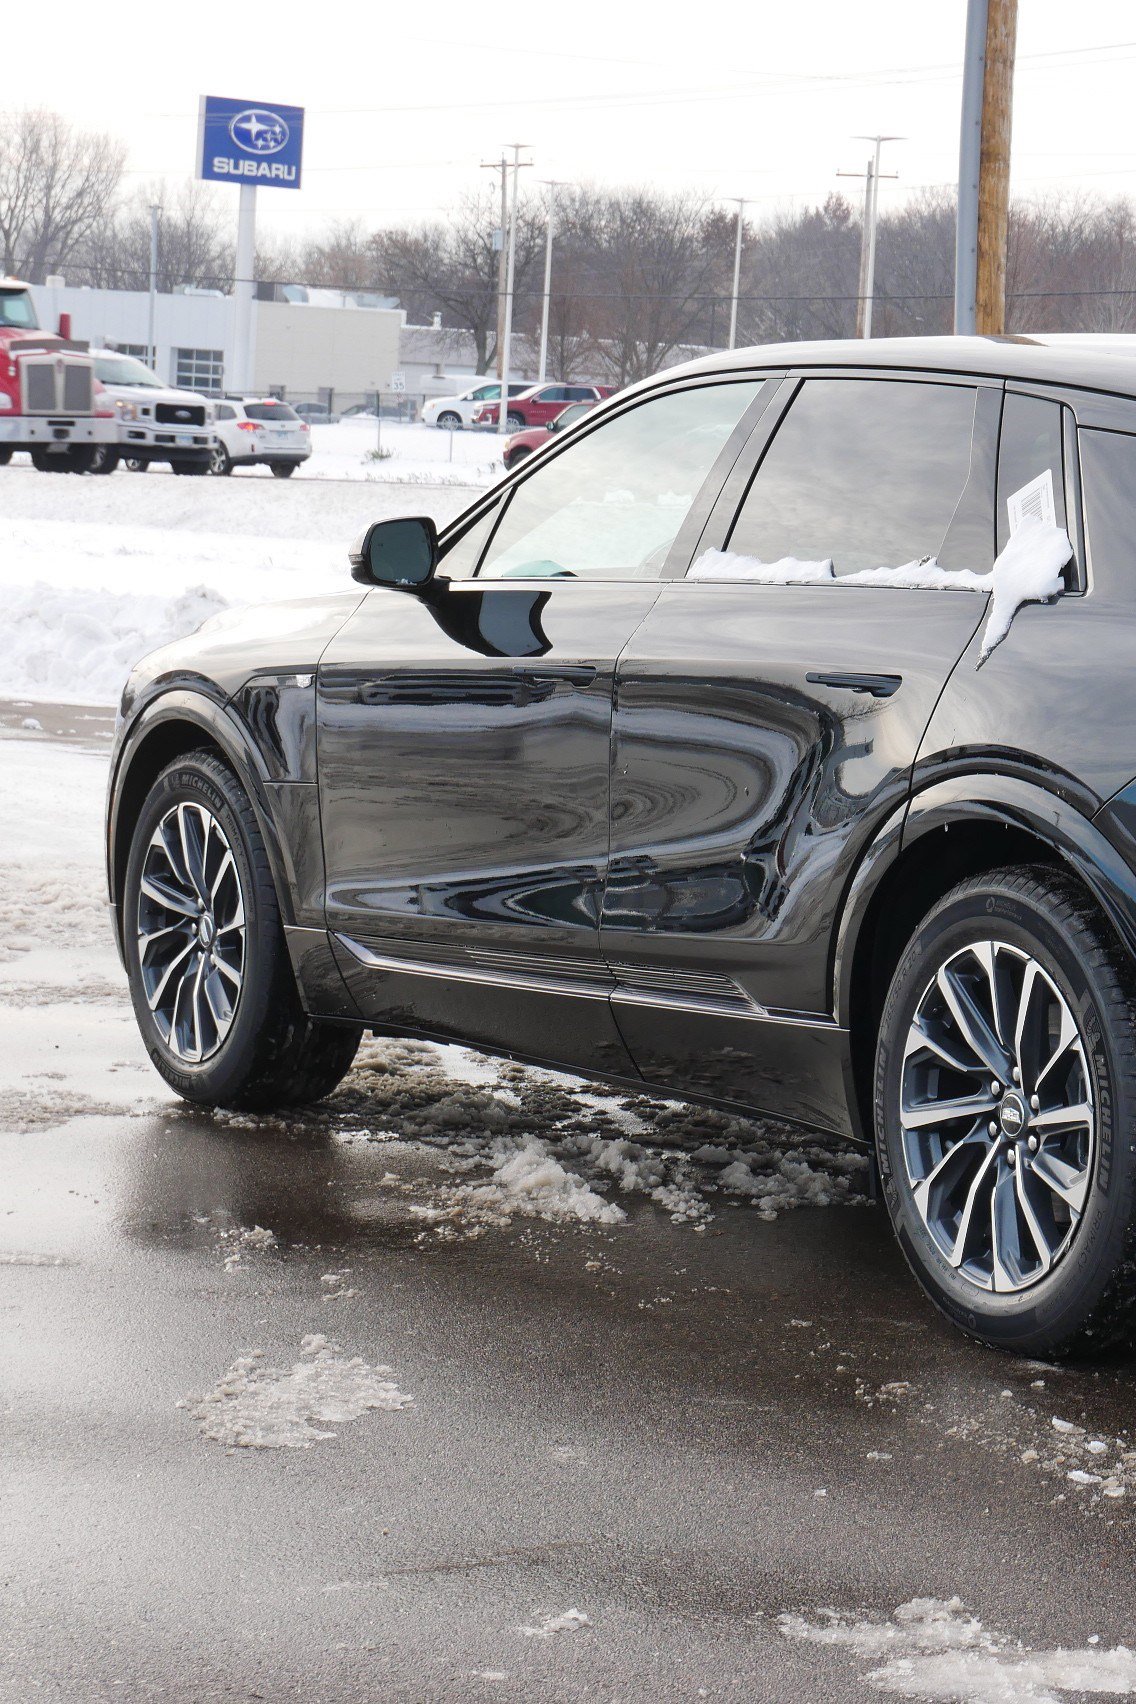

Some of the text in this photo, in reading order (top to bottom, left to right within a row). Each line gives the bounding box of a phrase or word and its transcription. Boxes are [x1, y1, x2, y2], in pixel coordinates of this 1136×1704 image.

[213, 157, 296, 180] SUBARU
[393, 382, 405, 390] 35
[181, 774, 222, 808] MICHELIN
[875, 1045, 892, 1176] MICHELIN
[1092, 1053, 1113, 1194] MICHELIN
